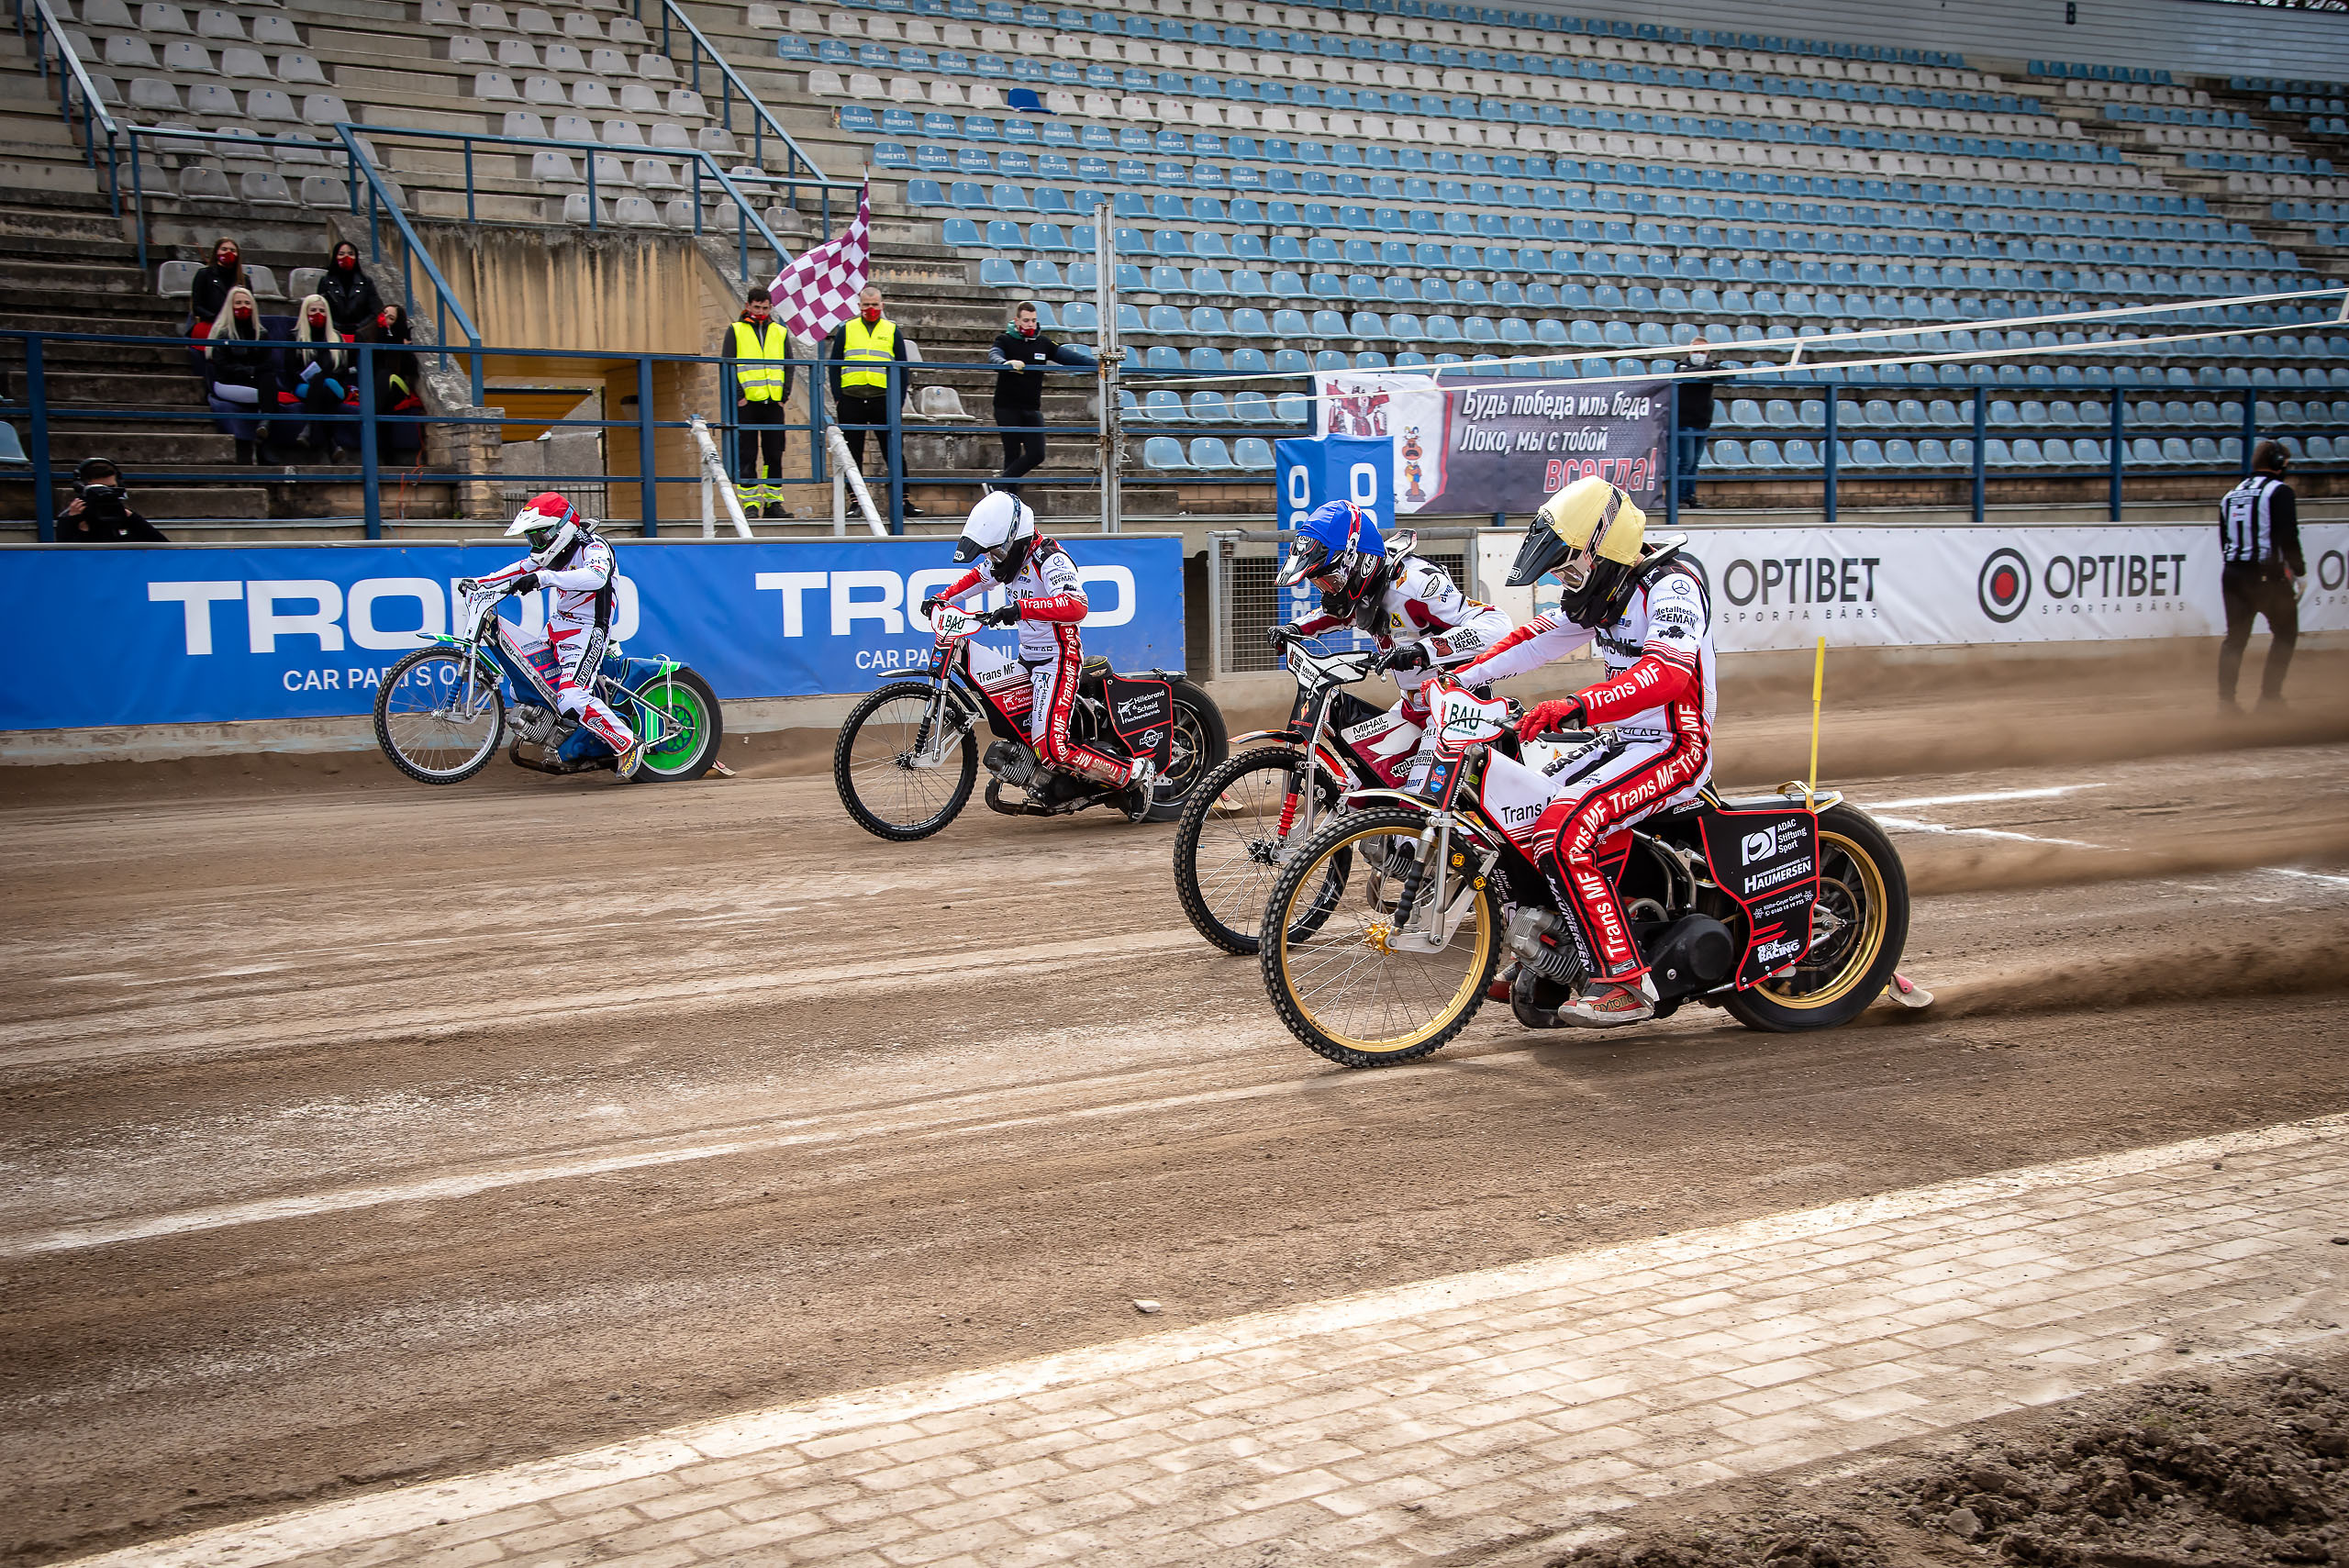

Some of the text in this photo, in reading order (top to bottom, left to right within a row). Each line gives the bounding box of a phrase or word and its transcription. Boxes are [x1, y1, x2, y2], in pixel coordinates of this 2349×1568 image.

[2065, 2, 2077, 25] B
[1463, 389, 1508, 421] Будь
[1512, 390, 1574, 419] победа
[1578, 396, 1609, 417] иль
[1611, 391, 1650, 419] беда
[1460, 424, 1609, 454] Локо, мы с тобой
[1723, 557, 1880, 606] OPTIBET
[2044, 554, 2187, 599] OPTIBET
[755, 565, 1136, 638] TROO
[1020, 595, 1070, 609] Trans MF
[1723, 606, 1878, 624] SPORTA BĀRS
[2042, 599, 2185, 615] SPORTA BĀRS
[945, 615, 965, 630] BAU
[1065, 628, 1077, 658] Trans
[855, 650, 900, 671] CAR
[976, 662, 1016, 684] Trans MF
[283, 669, 340, 691] CAR
[348, 664, 432, 690] PAS
[1058, 660, 1076, 707] Trans MF
[1581, 662, 1660, 710] Trans MF
[1133, 689, 1165, 705] Hillebrand
[1136, 700, 1159, 714] Schmid
[1054, 714, 1067, 732] MF
[1353, 717, 1388, 735] MIHAIL
[1449, 703, 1481, 730] BAU
[1678, 705, 1699, 732] MF
[1354, 724, 1389, 740] CHUMAKOV
[1072, 751, 1119, 780] Trans MF
[1676, 732, 1703, 774] Trans
[1655, 762, 1680, 791] MF
[1608, 783, 1656, 814] Trans
[1501, 804, 1542, 825] Trans
[1582, 800, 1608, 830] MF
[1777, 818, 1797, 832] ADAC
[1777, 827, 1808, 844] Stiftung
[1777, 840, 1798, 854] Sport
[1576, 872, 1607, 901] MF
[1744, 861, 1811, 895] HAUMERSEN
[1788, 892, 1803, 902] GmbH
[1596, 902, 1627, 959] Trans
[1757, 941, 1800, 963] RACING
